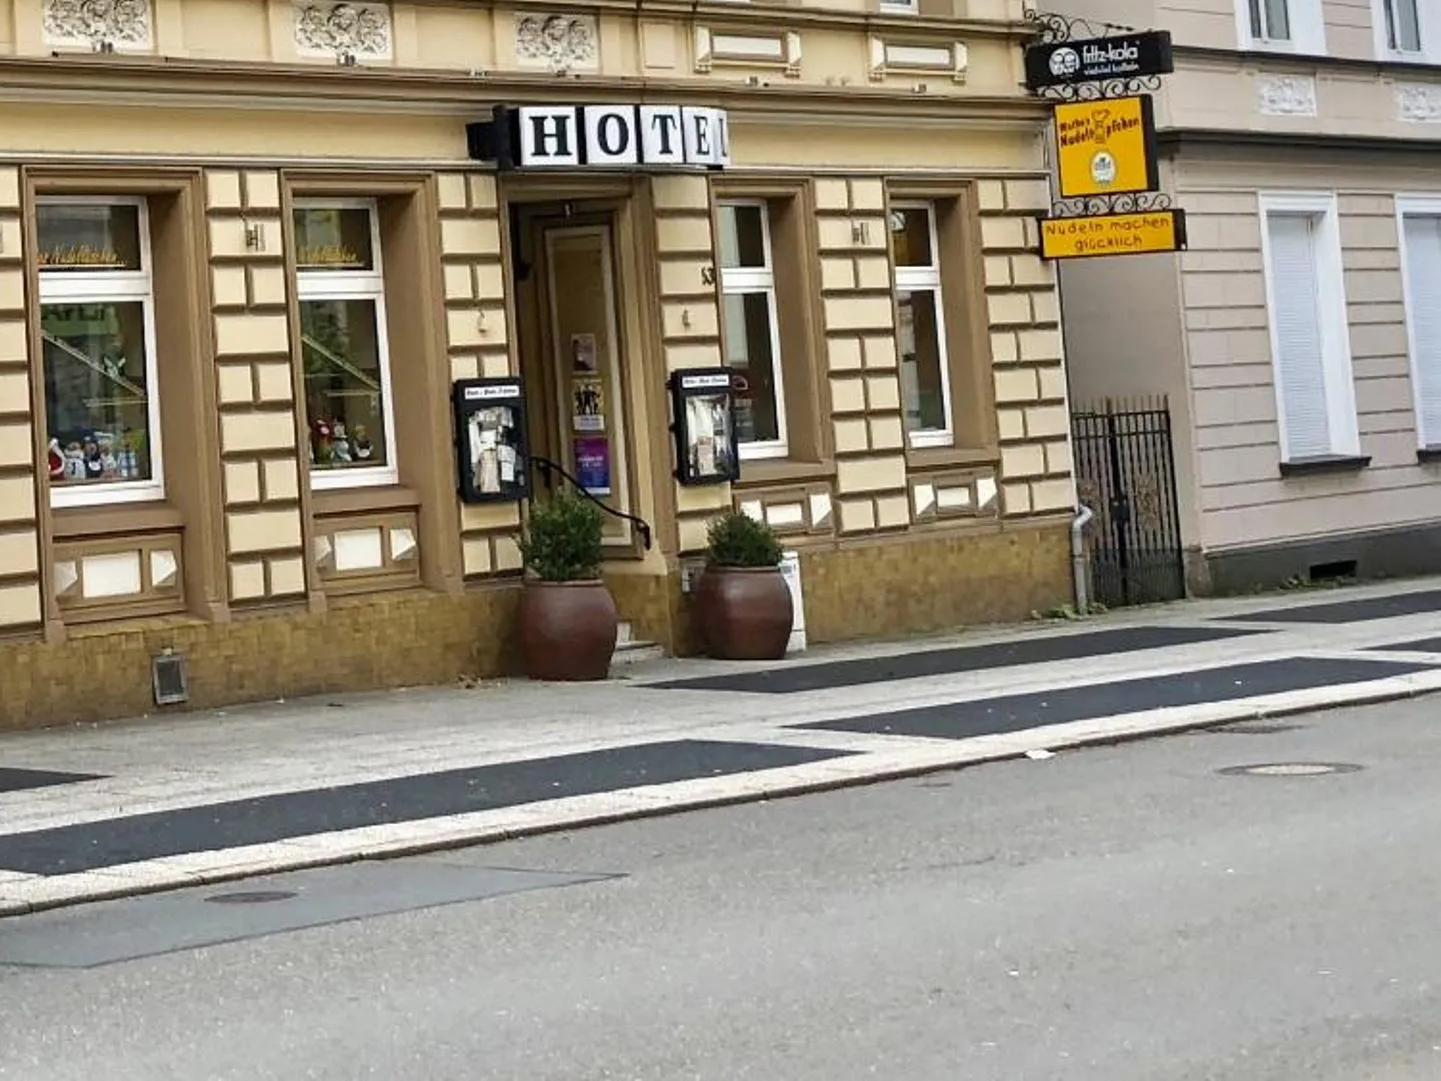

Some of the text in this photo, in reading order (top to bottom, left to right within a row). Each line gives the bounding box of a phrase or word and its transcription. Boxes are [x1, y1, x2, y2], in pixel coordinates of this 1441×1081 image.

[1082, 40, 1139, 64] fritz-kola
[1046, 216, 1169, 236] Nudeln machen
